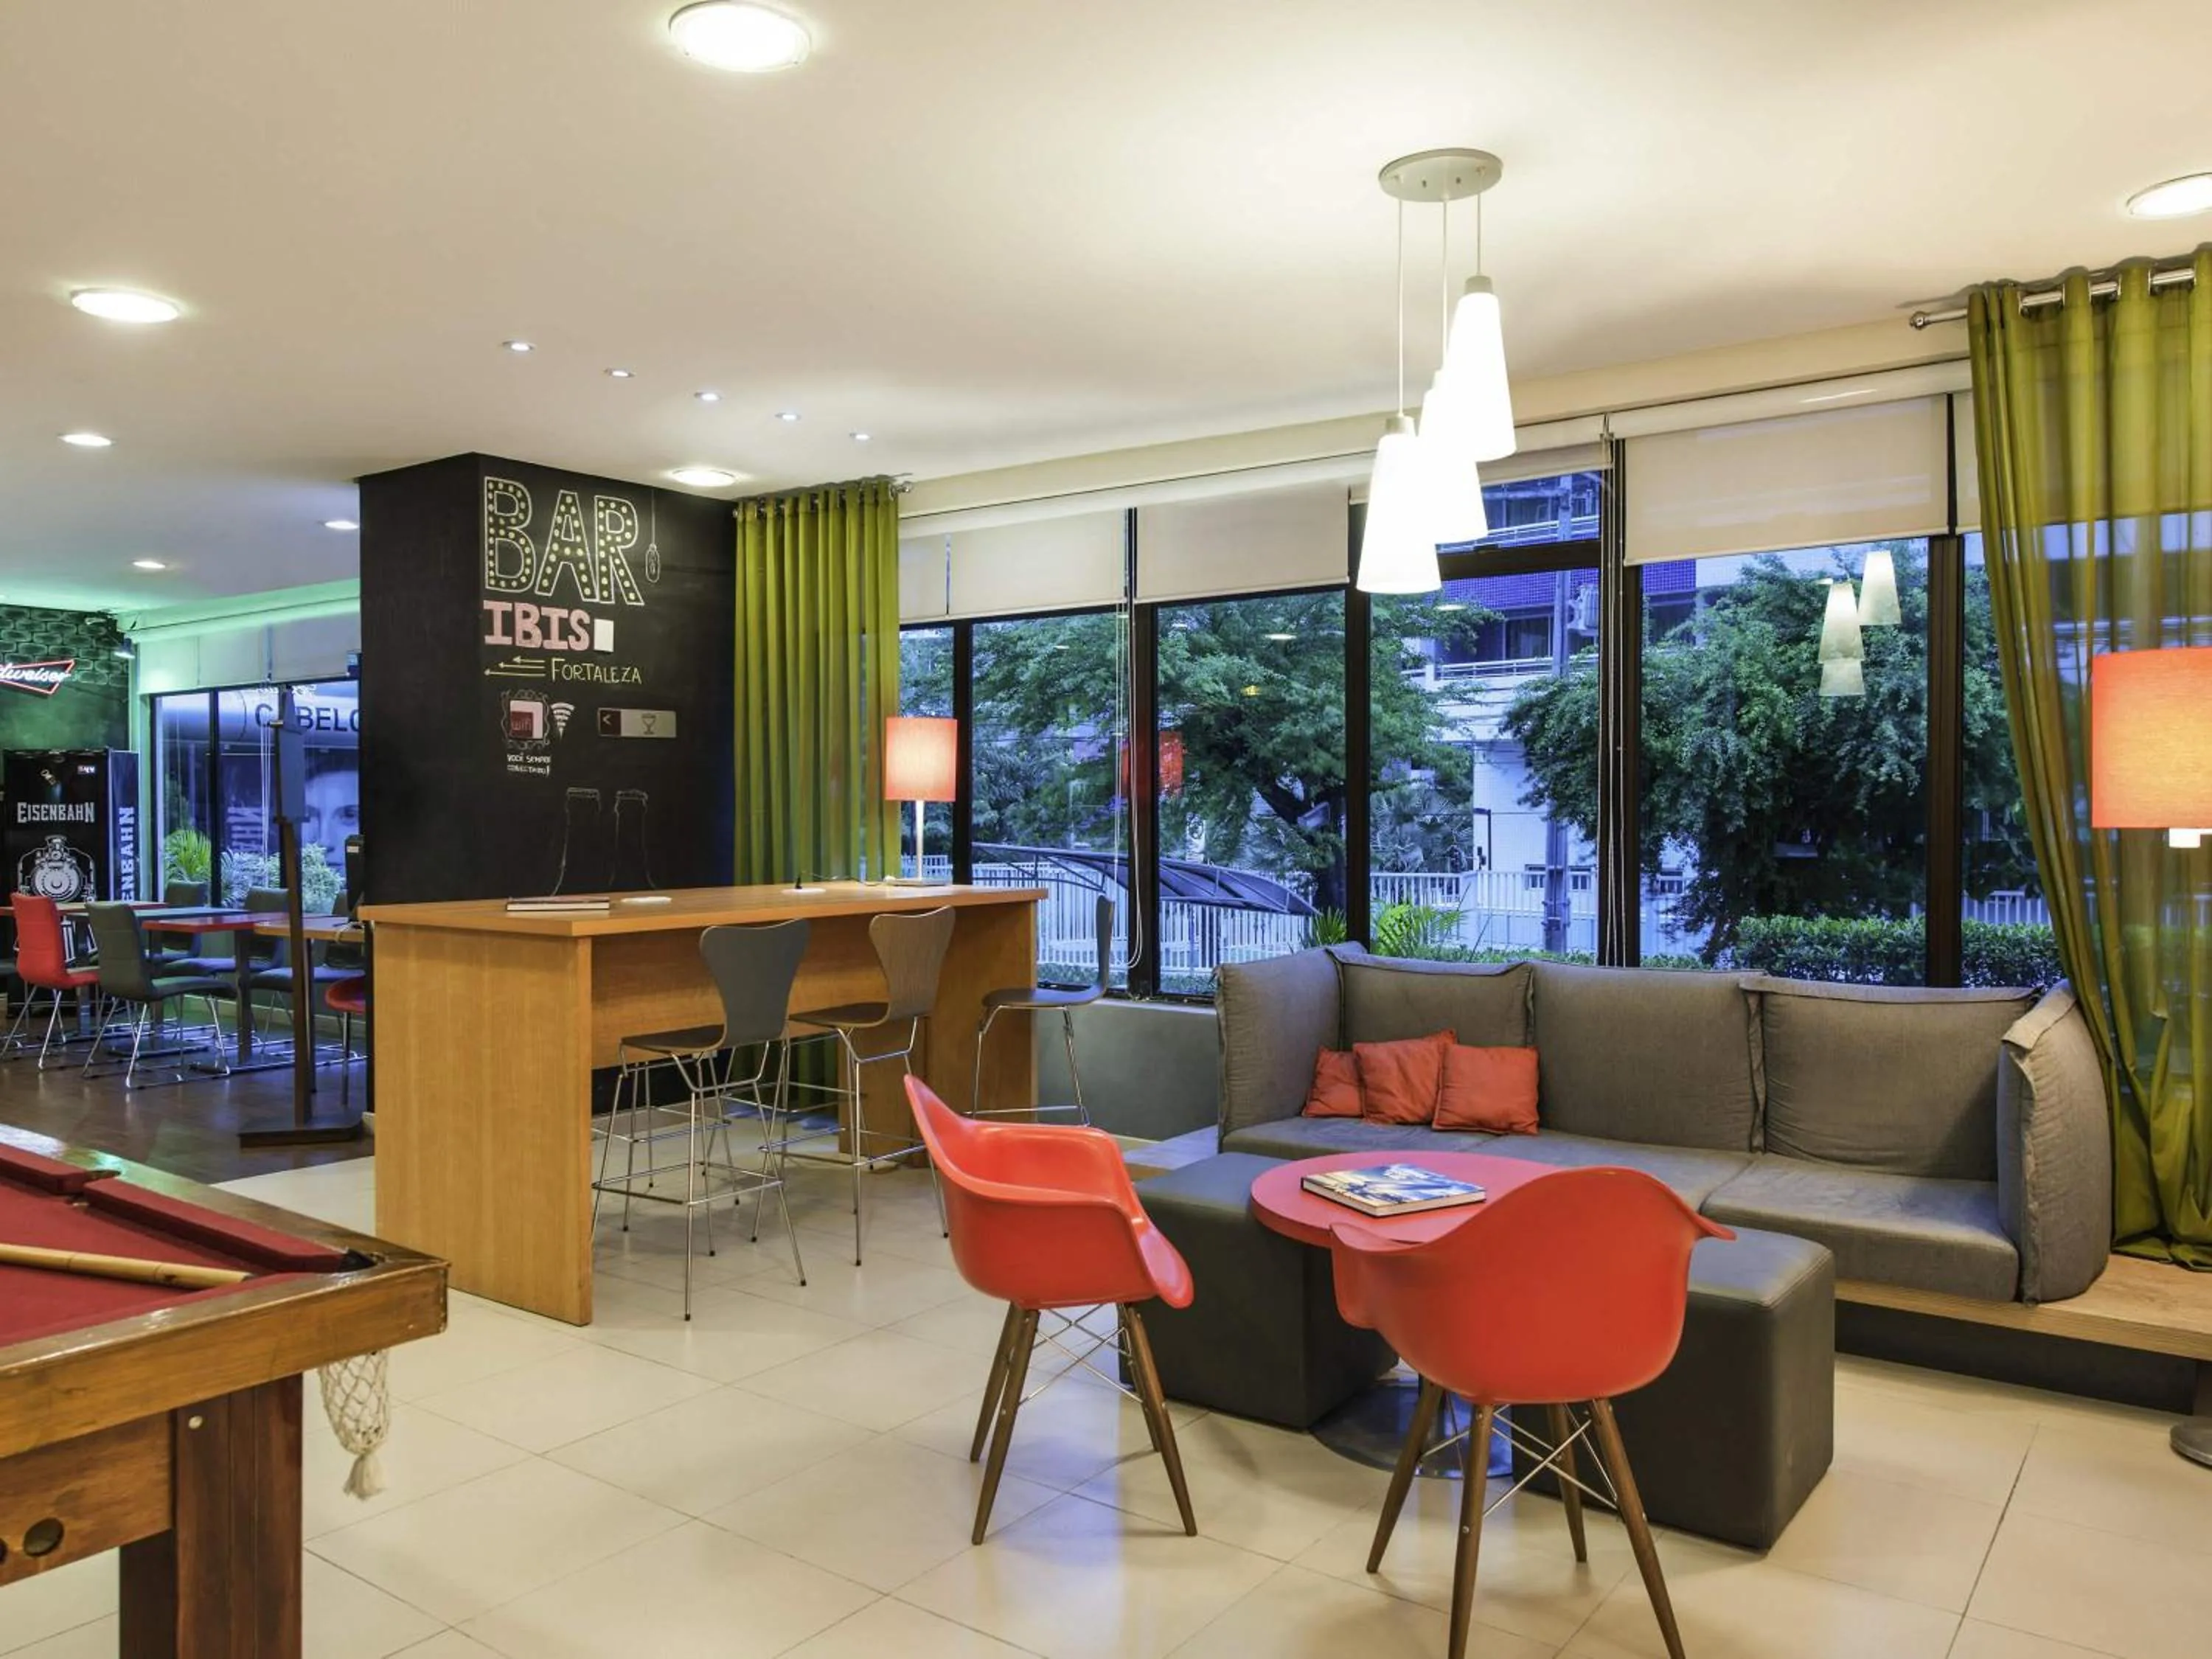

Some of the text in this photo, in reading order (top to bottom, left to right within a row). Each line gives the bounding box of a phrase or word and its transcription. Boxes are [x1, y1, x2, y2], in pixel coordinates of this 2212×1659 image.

[484, 476, 644, 605] BAR
[483, 599, 591, 651] IBIS
[552, 658, 641, 684] FORTALEZA
[17, 801, 95, 823] EISENBAHN
